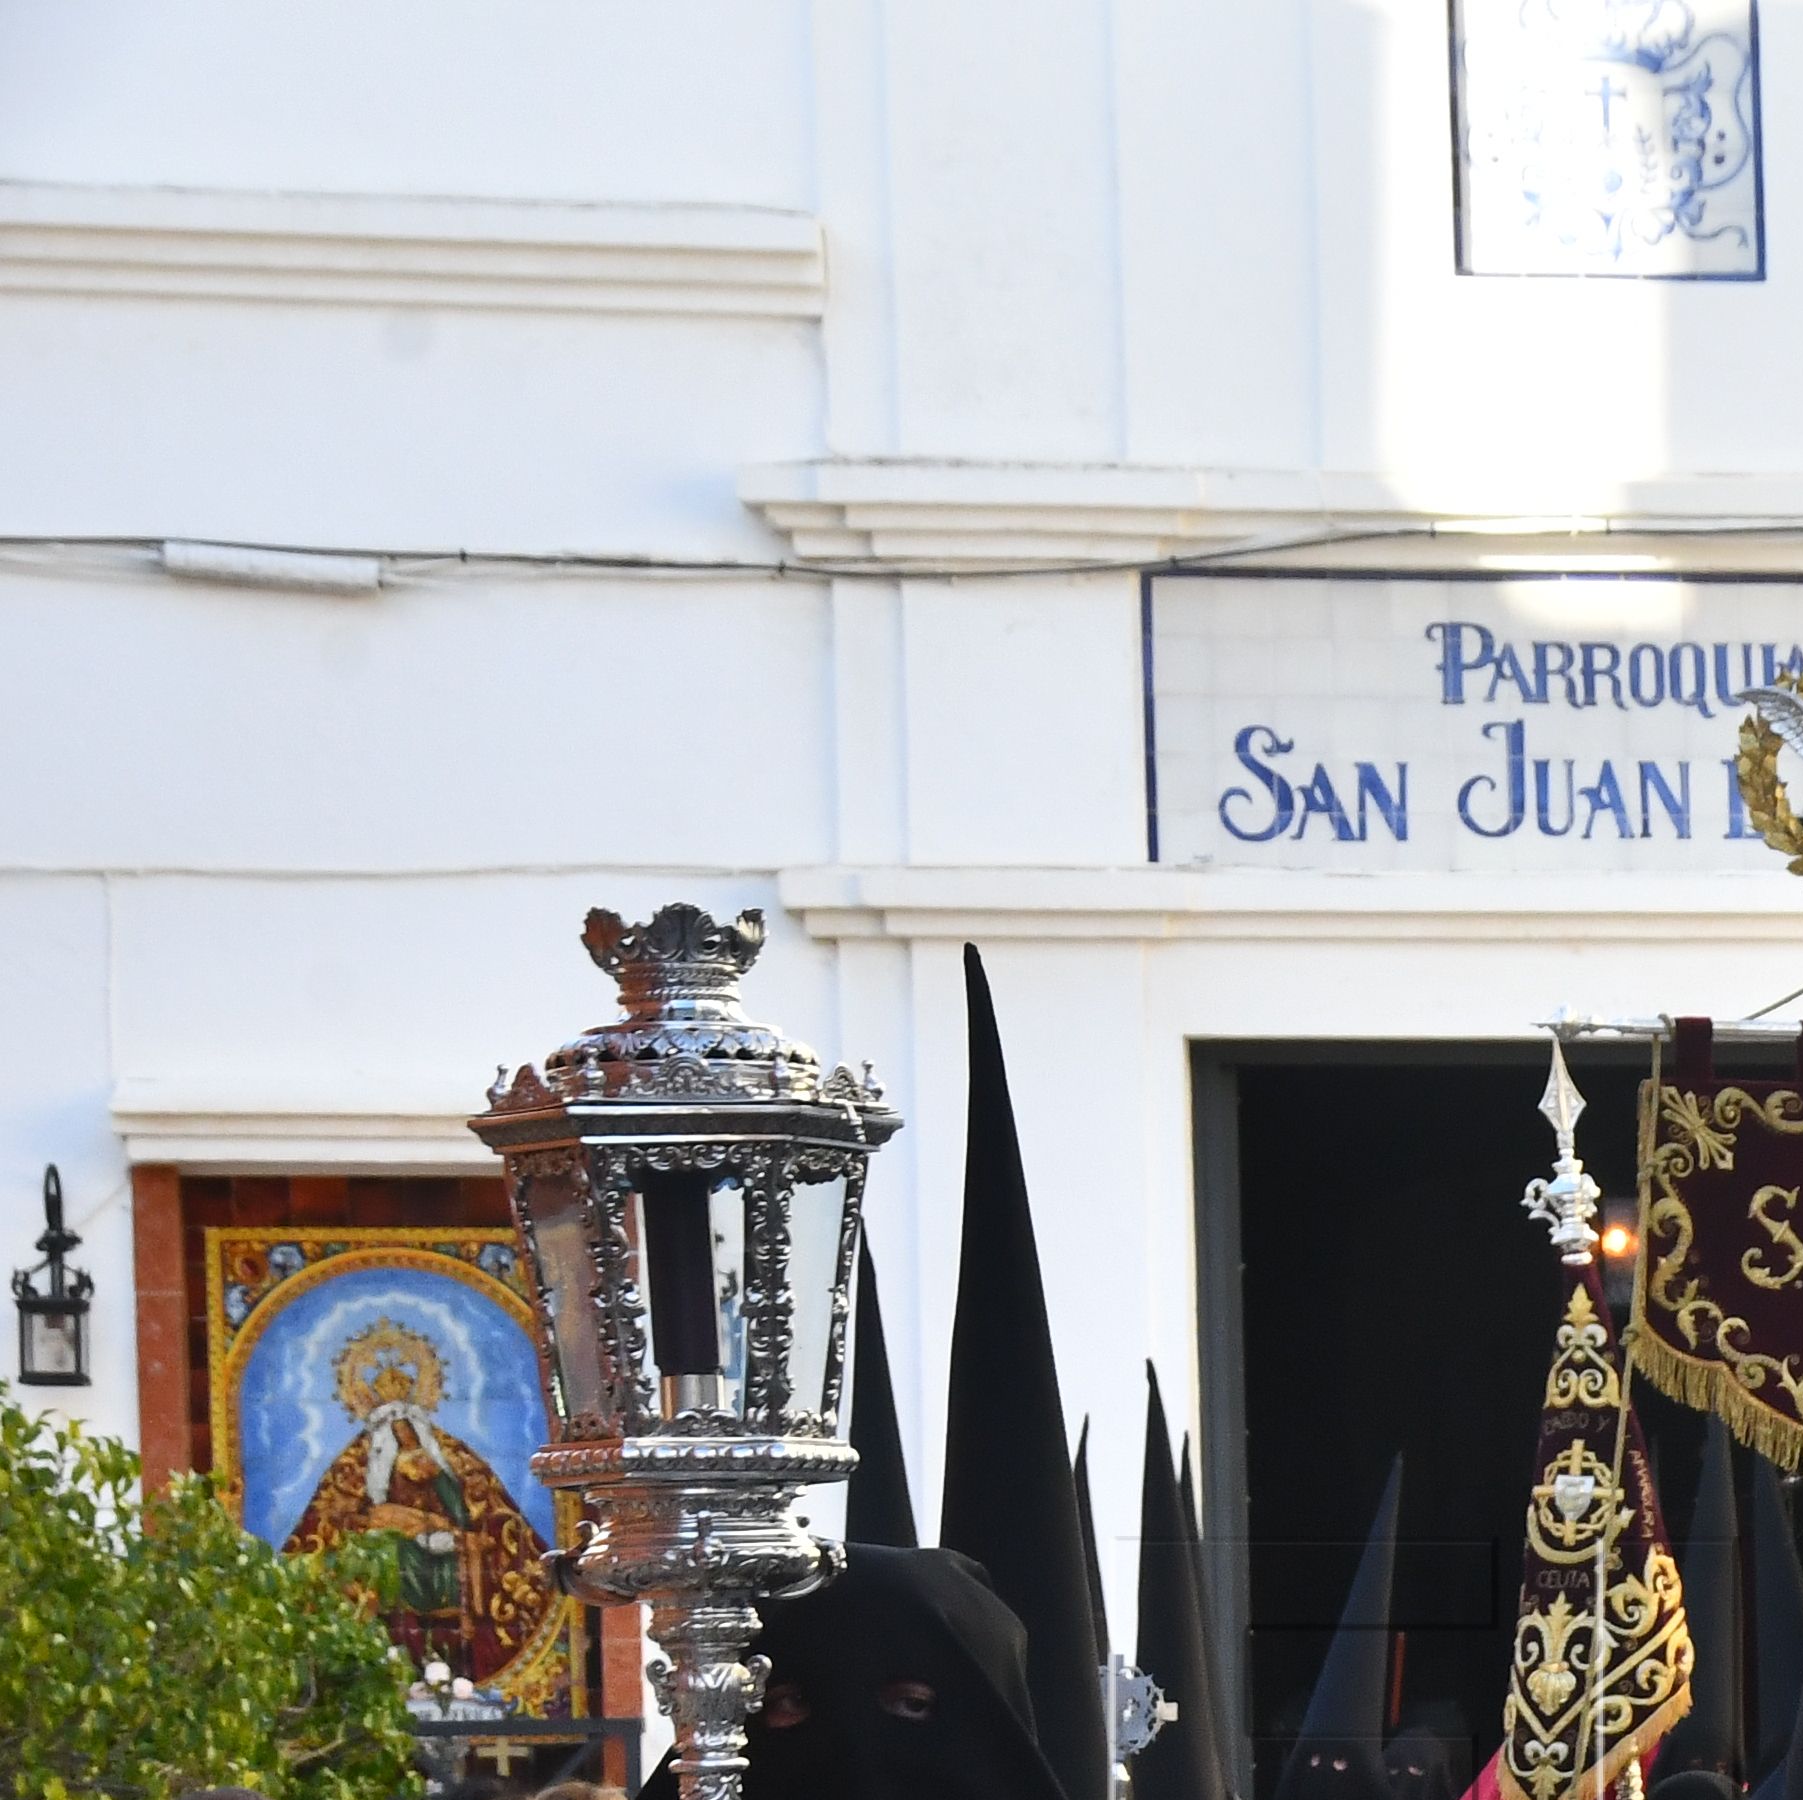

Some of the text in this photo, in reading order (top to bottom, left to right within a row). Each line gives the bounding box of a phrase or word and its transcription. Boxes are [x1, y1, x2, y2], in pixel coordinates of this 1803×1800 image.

[1218, 724, 1409, 842] SAN
[1457, 718, 1692, 840] JUAN
[1536, 1569, 1591, 1589] CEUTA
